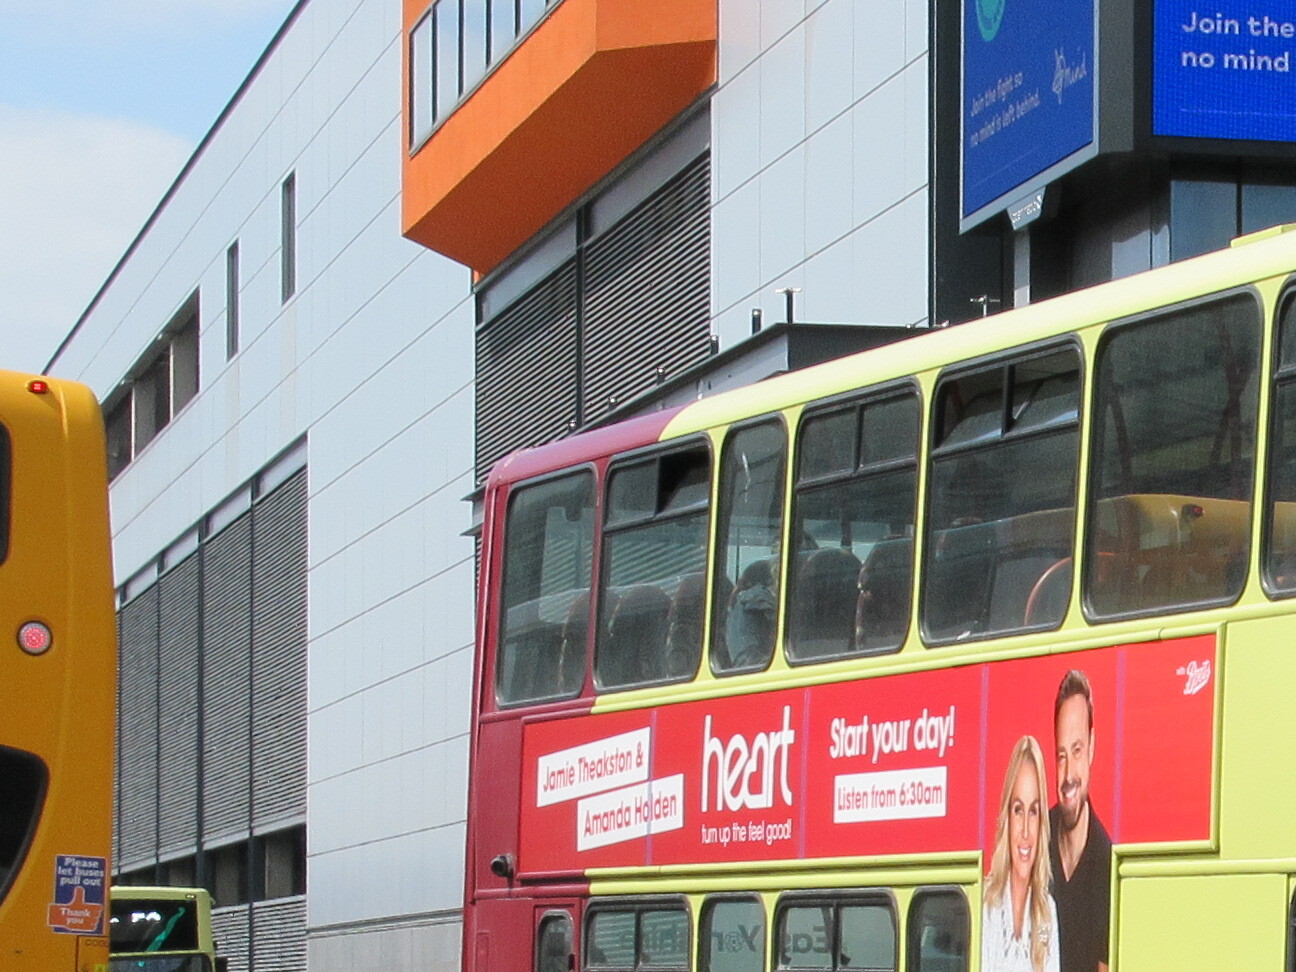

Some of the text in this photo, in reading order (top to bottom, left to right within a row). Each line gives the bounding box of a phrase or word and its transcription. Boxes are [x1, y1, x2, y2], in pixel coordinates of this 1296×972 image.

[1181, 11, 1240, 36] Join
[1246, 16, 1295, 38] the
[1181, 51, 1215, 69] no
[1223, 49, 1290, 73] mind
[829, 705, 956, 764] Start your day!
[543, 741, 644, 793] Jamie Theakston &
[701, 705, 796, 813] heart
[838, 781, 943, 811] Listen from 6:30am
[584, 794, 677, 839] Amanda Holden
[702, 818, 792, 847] turn up the feel good!
[58, 866, 104, 877] let buses
[64, 857, 99, 869] Please
[60, 877, 102, 887] pull out
[60, 907, 91, 917] Thank
[66, 917, 84, 926] you
